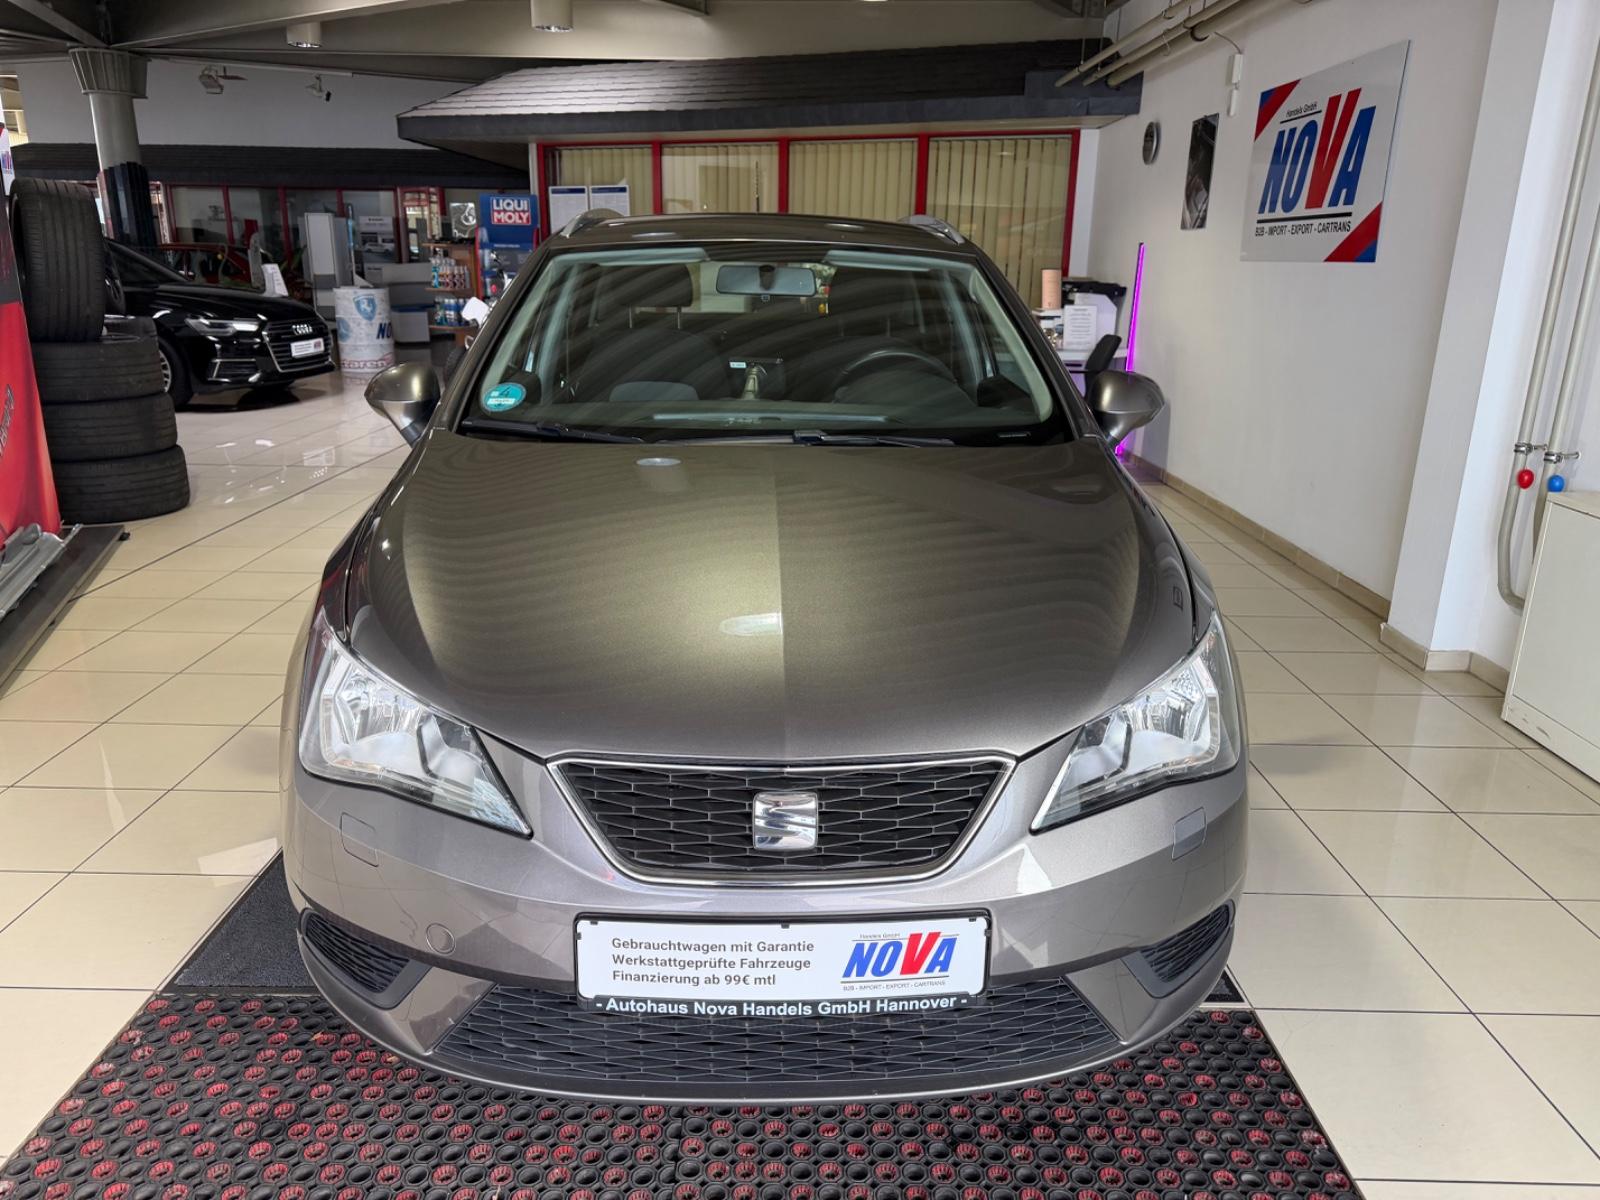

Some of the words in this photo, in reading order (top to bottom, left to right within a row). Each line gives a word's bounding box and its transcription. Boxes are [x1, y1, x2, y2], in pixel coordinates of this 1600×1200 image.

[1258, 88, 1376, 214] NOVA
[493, 199, 528, 211] LIQUI
[493, 212, 529, 223] MOLY
[1268, 225, 1287, 236] IMPORT
[1291, 223, 1314, 235] EXPORT
[1317, 221, 1351, 233] CARTRANS
[612, 937, 726, 954] Gebrauchtwagen
[730, 940, 753, 952] mit
[756, 941, 815, 952] Garantie
[612, 954, 736, 970] Werkstattgeprüfte
[740, 957, 811, 970] Fahrzeuge
[842, 932, 957, 978] NOVA
[612, 970, 700, 986] Finanzierung
[704, 974, 720, 985] ab
[724, 974, 750, 985] 99€
[754, 974, 776, 985] mtl
[605, 997, 688, 1014] Autohaus
[693, 1001, 738, 1015] Nova
[743, 1001, 812, 1016] Handels
[818, 1000, 870, 1014] GmbH
[876, 997, 957, 1012] Hannover
